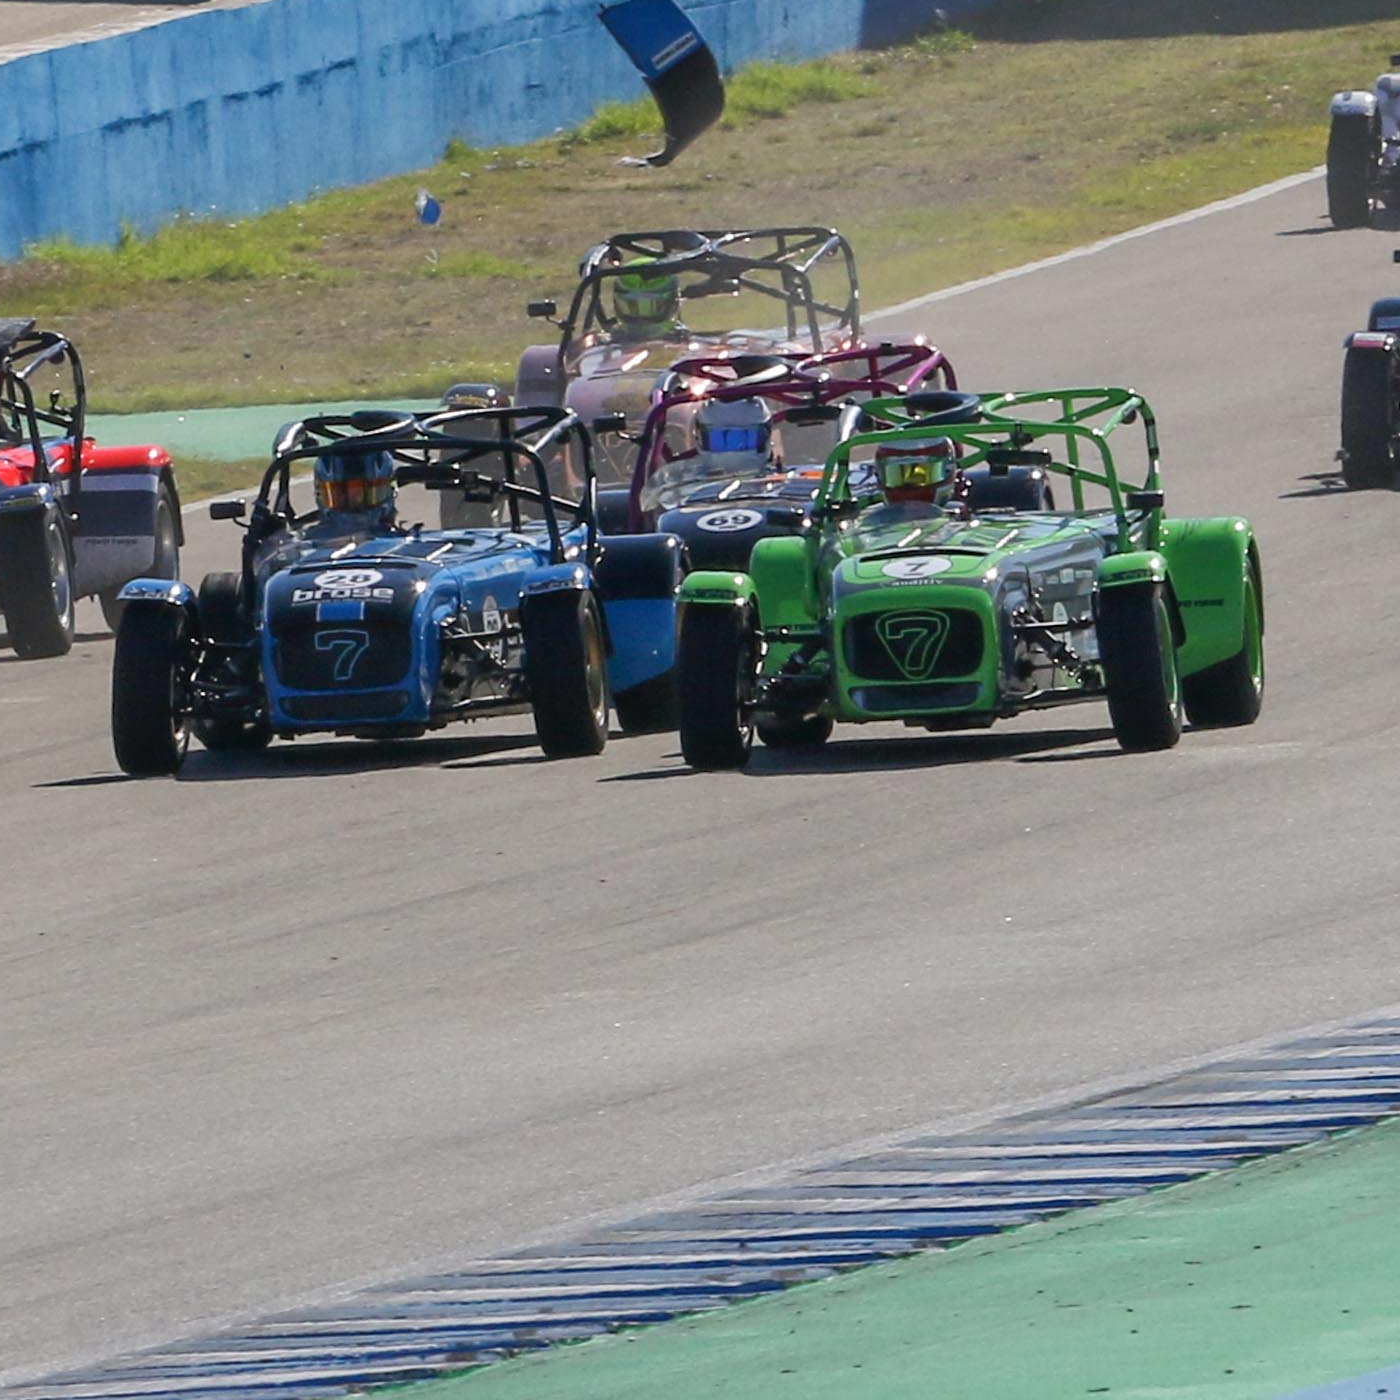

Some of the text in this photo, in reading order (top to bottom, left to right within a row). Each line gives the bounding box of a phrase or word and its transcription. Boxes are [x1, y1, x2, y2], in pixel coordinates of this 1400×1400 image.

[707, 514, 752, 526] 69
[905, 561, 930, 572] 7
[322, 574, 372, 586] 28
[292, 587, 395, 602] brose
[885, 616, 942, 671] 7
[314, 628, 370, 680] 7
